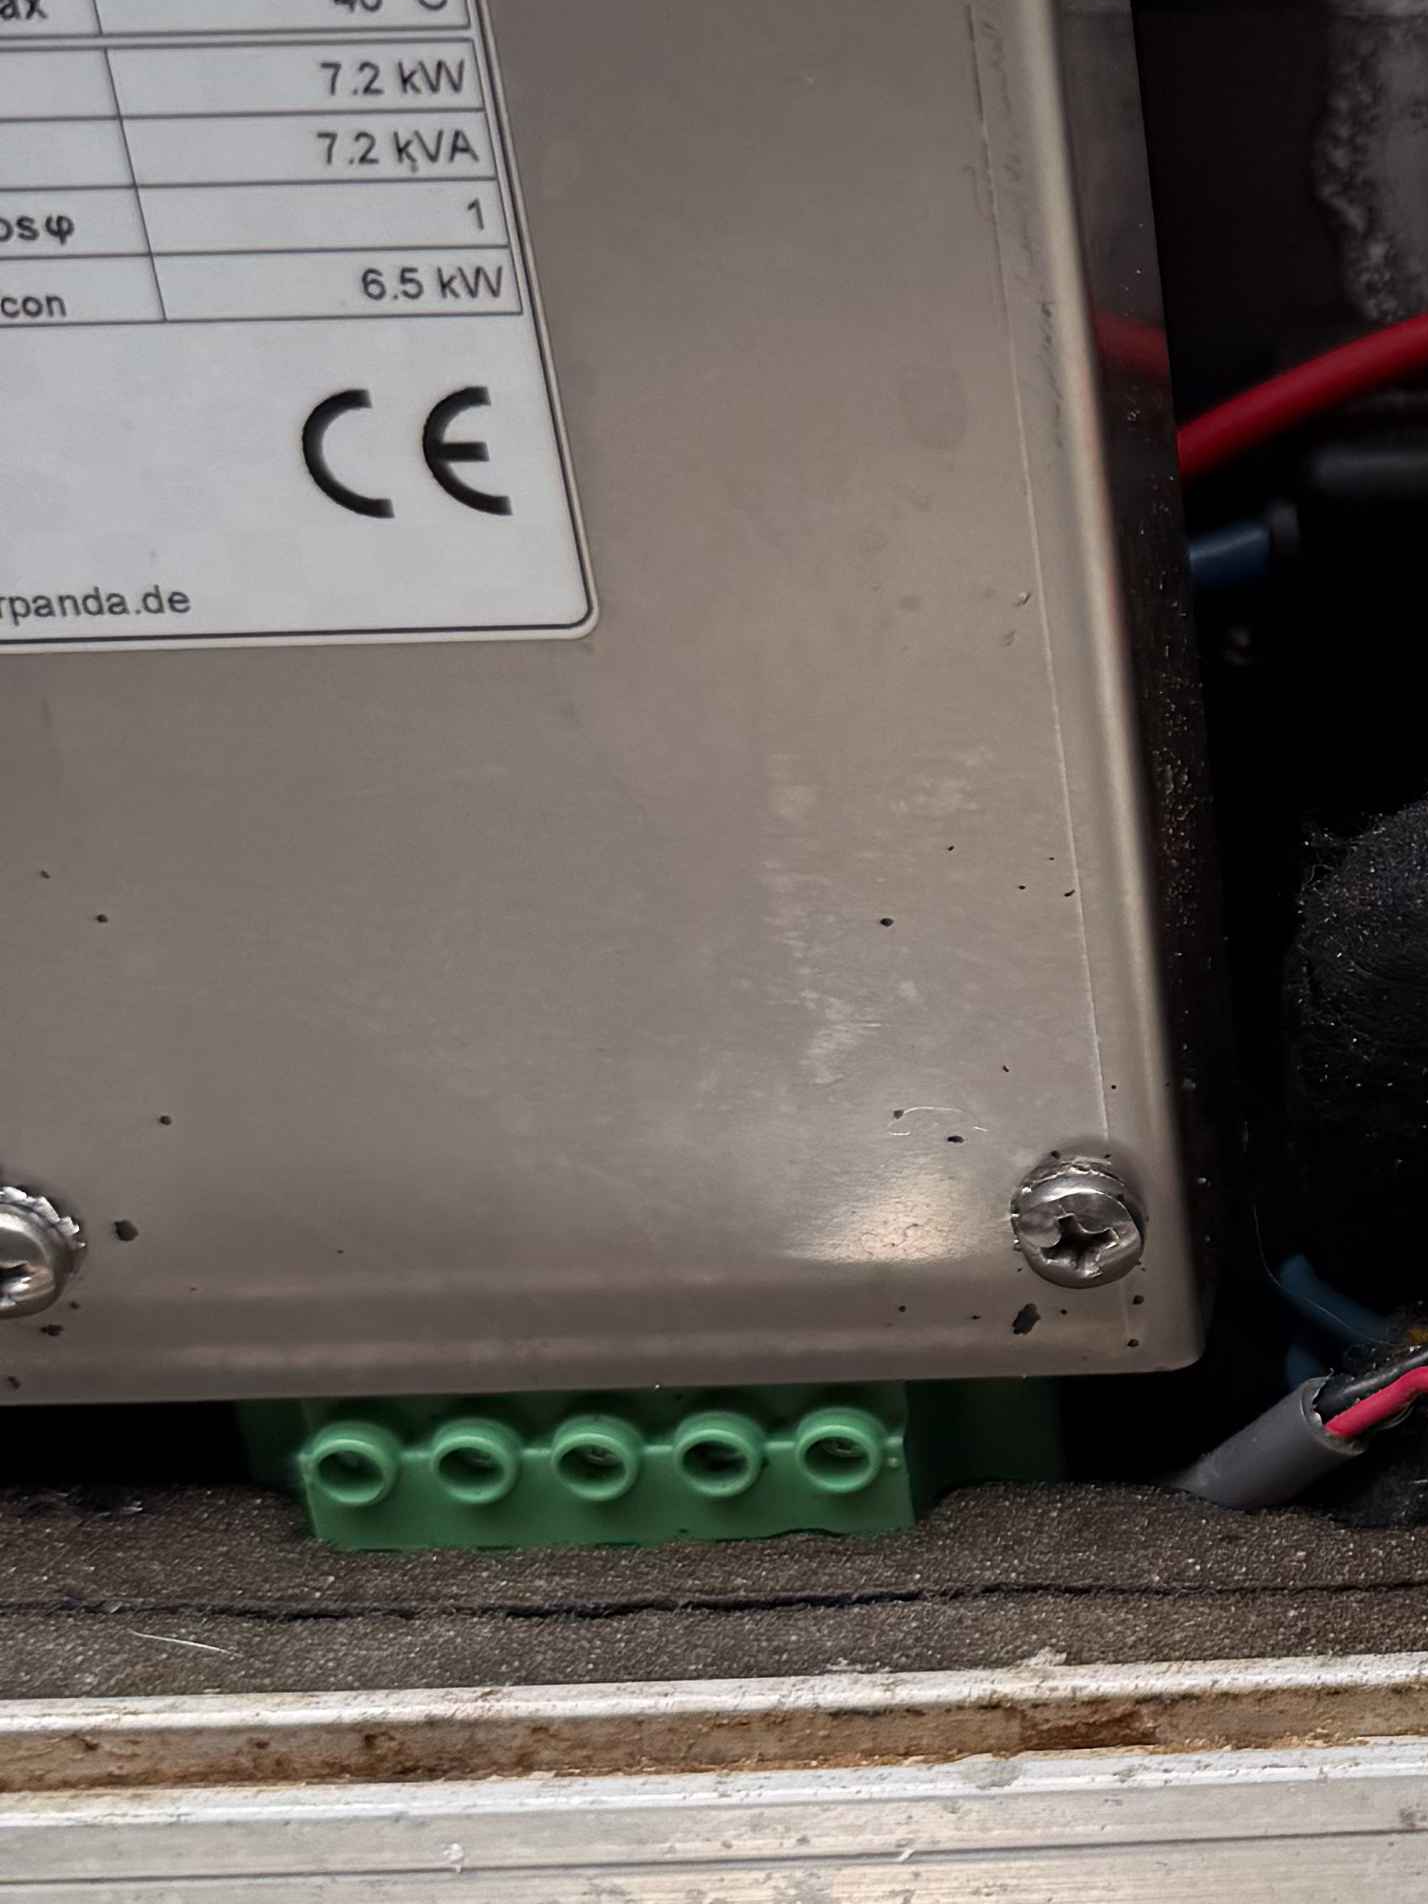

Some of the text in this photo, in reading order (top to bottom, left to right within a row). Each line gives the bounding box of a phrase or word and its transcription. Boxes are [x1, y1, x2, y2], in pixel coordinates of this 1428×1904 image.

[320, 59, 465, 96] 7.2 kW
[318, 132, 479, 165] 7.2 kVA
[467, 199, 484, 230] 1
[361, 266, 503, 301] 6.5 kW
